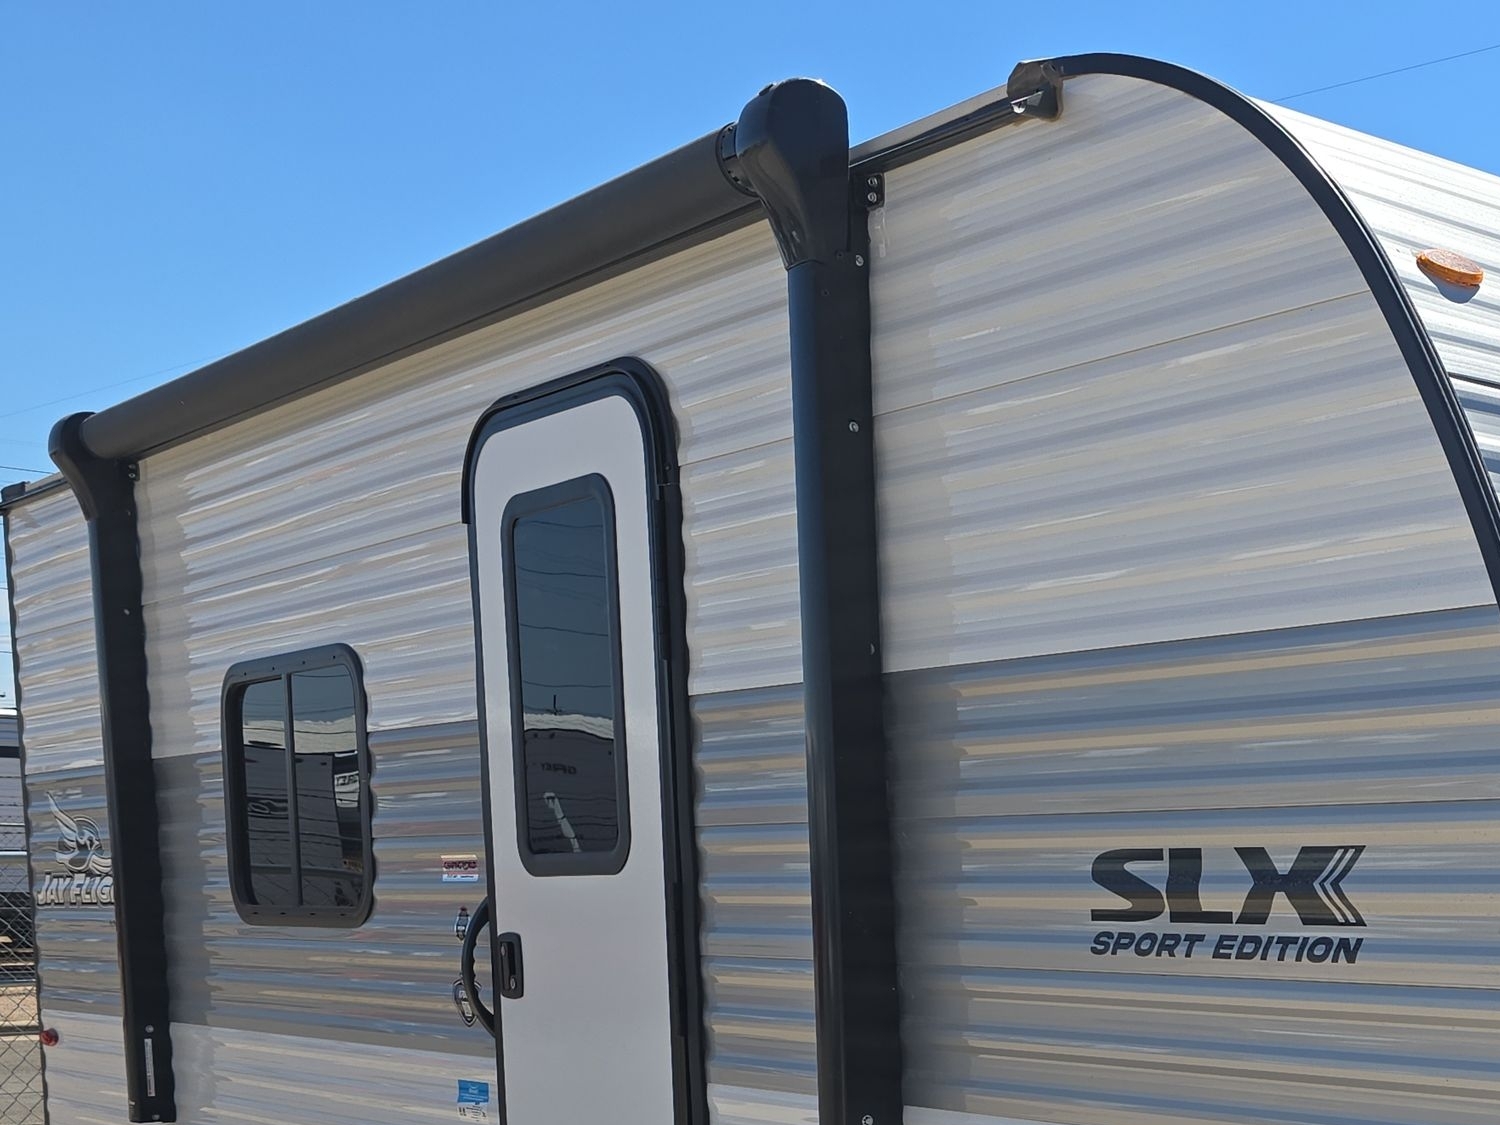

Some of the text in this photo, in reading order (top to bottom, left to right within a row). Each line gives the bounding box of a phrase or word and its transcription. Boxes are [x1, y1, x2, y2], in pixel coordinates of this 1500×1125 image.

[37, 870, 71, 906] JAY
[1090, 845, 1367, 927] SLX
[1090, 931, 1364, 964] SPORT EDITION
